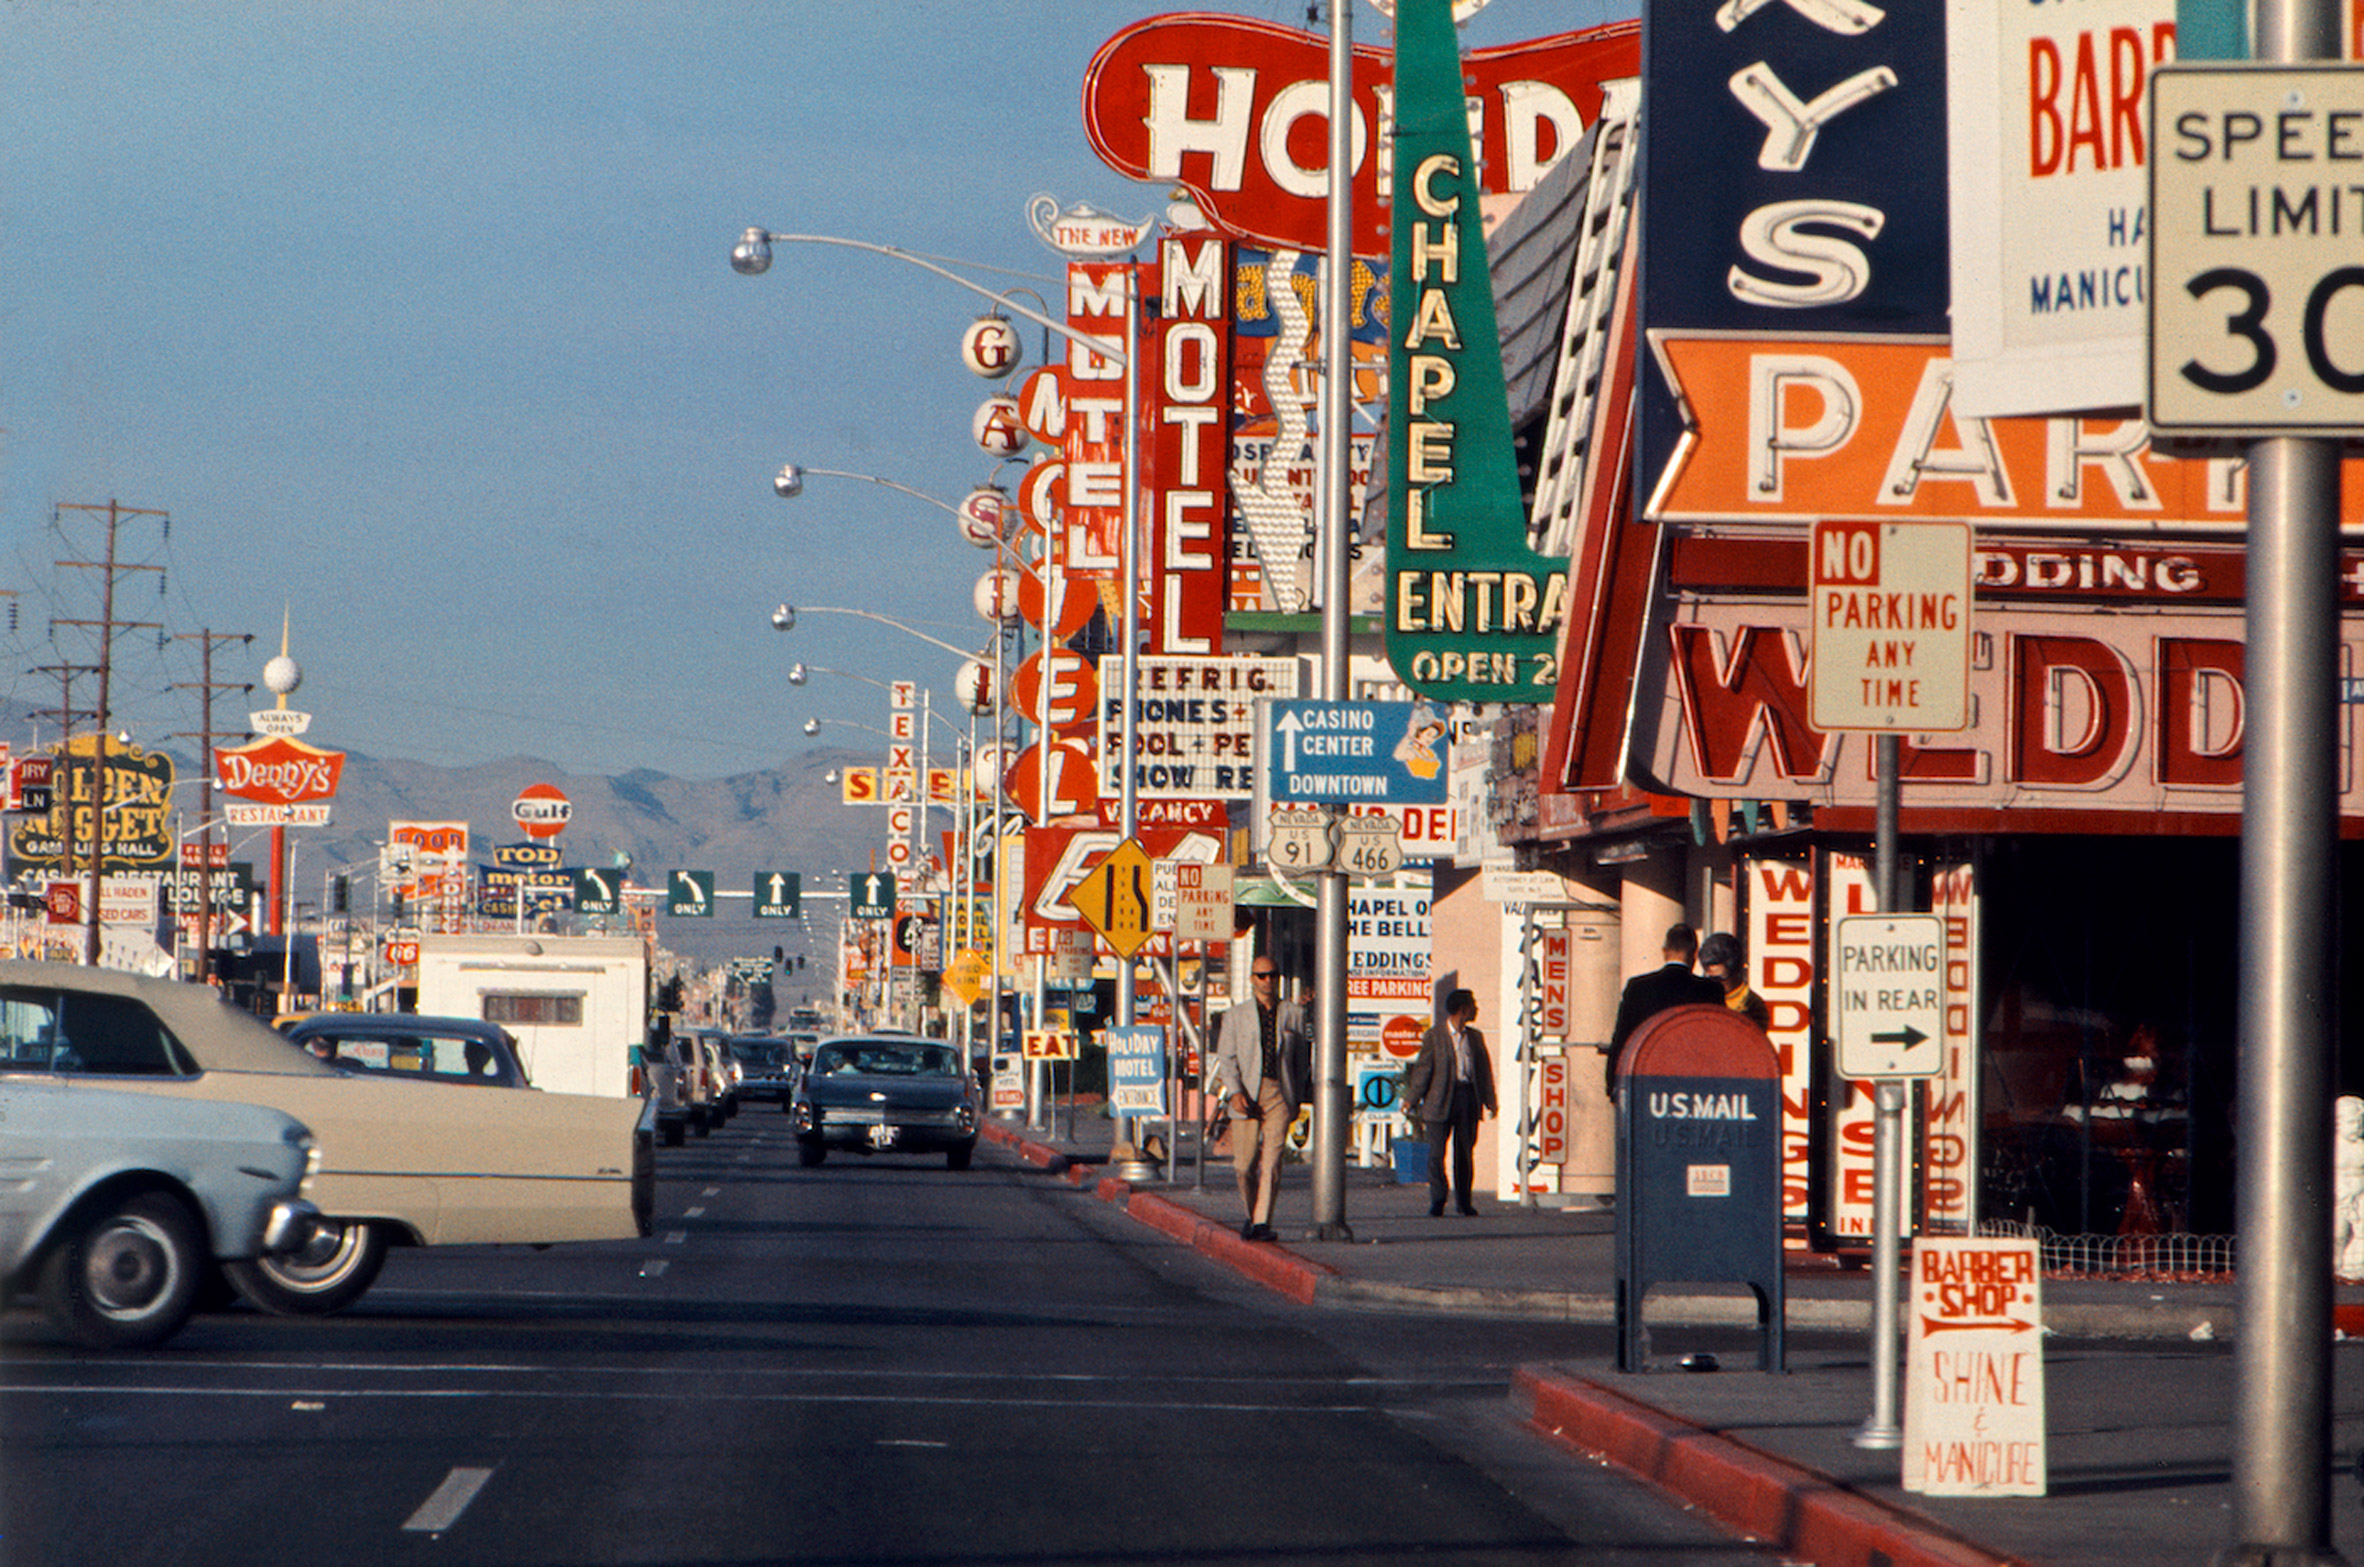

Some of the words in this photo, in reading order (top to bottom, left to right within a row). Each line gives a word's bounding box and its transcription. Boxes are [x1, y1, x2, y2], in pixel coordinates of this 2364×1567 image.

[2029, 22, 2176, 177] BAR
[2175, 111, 2363, 162] SPEE
[1057, 227, 1091, 245] THE
[1099, 228, 1138, 246] NEW
[2181, 265, 2364, 395] 30
[1405, 154, 1462, 550] CHAPEL
[1068, 272, 1126, 569] MOTEL
[1748, 354, 2248, 512] PAR
[1161, 239, 1222, 655] MOTEL
[1822, 530, 1874, 580] NO
[1398, 570, 1569, 633] ENTRA
[1827, 592, 1957, 630] PARKING
[1866, 640, 1915, 668] ANY
[1138, 667, 1275, 691] EFRIG.
[1412, 651, 1516, 685] OPEN
[1861, 678, 1920, 708] TIME
[260, 713, 303, 723] ALWAYS
[267, 724, 294, 733] OPEN
[1303, 709, 1374, 730] CASINO
[1303, 735, 1374, 757] CENTER
[222, 755, 332, 799] Denny's
[889, 684, 912, 862] TEXACO
[1289, 775, 1387, 796] DOWNTOWN
[514, 802, 571, 819] Gulf
[1105, 802, 1213, 824] VCANCY
[1279, 815, 1320, 825] NEVADA
[1350, 820, 1391, 831] NEVADA
[1403, 808, 1456, 841] DE
[500, 847, 558, 863] TOD
[1285, 842, 1311, 865] 91
[1352, 848, 1388, 870] 466
[487, 872, 570, 886] motor
[1181, 867, 1199, 887] NO
[582, 900, 613, 912] ONLY
[1182, 889, 1229, 905] PARKING
[675, 903, 707, 915] ONLY
[760, 905, 792, 917] ONLY
[857, 906, 888, 917] ONLY
[1195, 907, 1214, 918] ANY
[1193, 920, 1216, 932] TIME
[1377, 921, 1432, 937] BELL
[1843, 944, 1938, 972] PARKING
[1372, 980, 1432, 998] PARKING
[1546, 936, 1566, 1028] MENS
[1845, 990, 1867, 1010] IN
[1878, 988, 1938, 1010] REAR
[1027, 1035, 1073, 1057] EAT
[1114, 1058, 1157, 1077] MOTEL
[1544, 1063, 1565, 1157] SHOP
[1840, 1217, 1874, 1233] IN
[1921, 1250, 2035, 1284] BARBER
[1939, 1283, 2016, 1317] SHOP
[1933, 1350, 2028, 1406] SHINE
[1924, 1440, 2039, 1486] MANICURE
